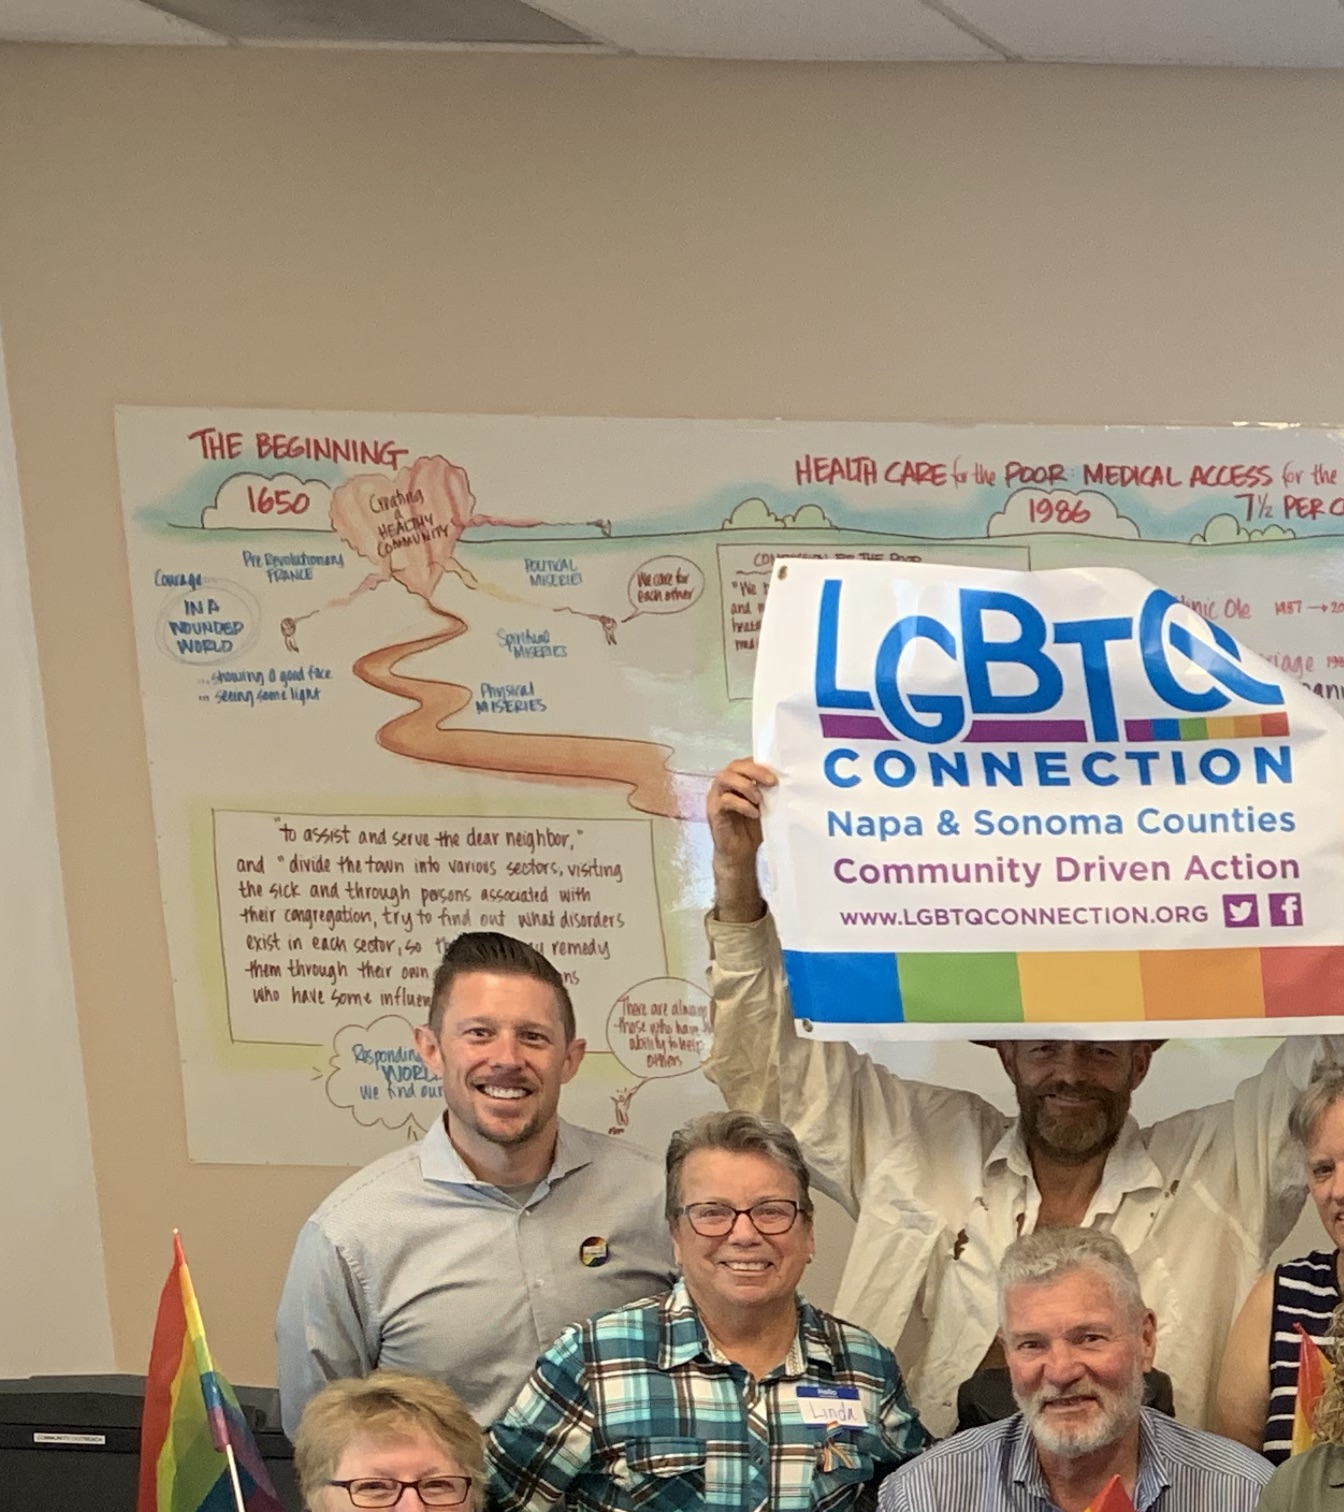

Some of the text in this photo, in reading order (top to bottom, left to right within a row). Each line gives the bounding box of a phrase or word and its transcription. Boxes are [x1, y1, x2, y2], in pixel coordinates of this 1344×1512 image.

[187, 427, 409, 471] THE BEGINNING
[795, 454, 947, 486] HEALTH CARE
[1083, 463, 1182, 488] MEDICAL
[1189, 464, 1274, 487] ACCESS
[1282, 461, 1303, 486] for
[1313, 463, 1338, 485] the
[247, 486, 310, 514] 1650
[1029, 498, 1091, 525] 1986
[177, 639, 233, 655] WORLD
[815, 578, 1286, 744] LGBTQ
[476, 696, 548, 714] MISERIES
[822, 745, 1293, 788] CONNECTION
[303, 824, 500, 847] assist and serve dear
[827, 805, 1297, 842] Napa & Sonoma Counties
[236, 854, 624, 883] and into various visiting
[833, 850, 1301, 888] Community Driven Action
[269, 880, 592, 907] sick through with
[240, 905, 625, 929] their find what disorders
[840, 905, 1209, 927] www.LGBTQCONNECTION.ORG
[245, 931, 611, 960] exist remedy
[245, 958, 392, 986] them through their
[292, 985, 325, 1005] have
[809, 1400, 859, 1423] Linda
